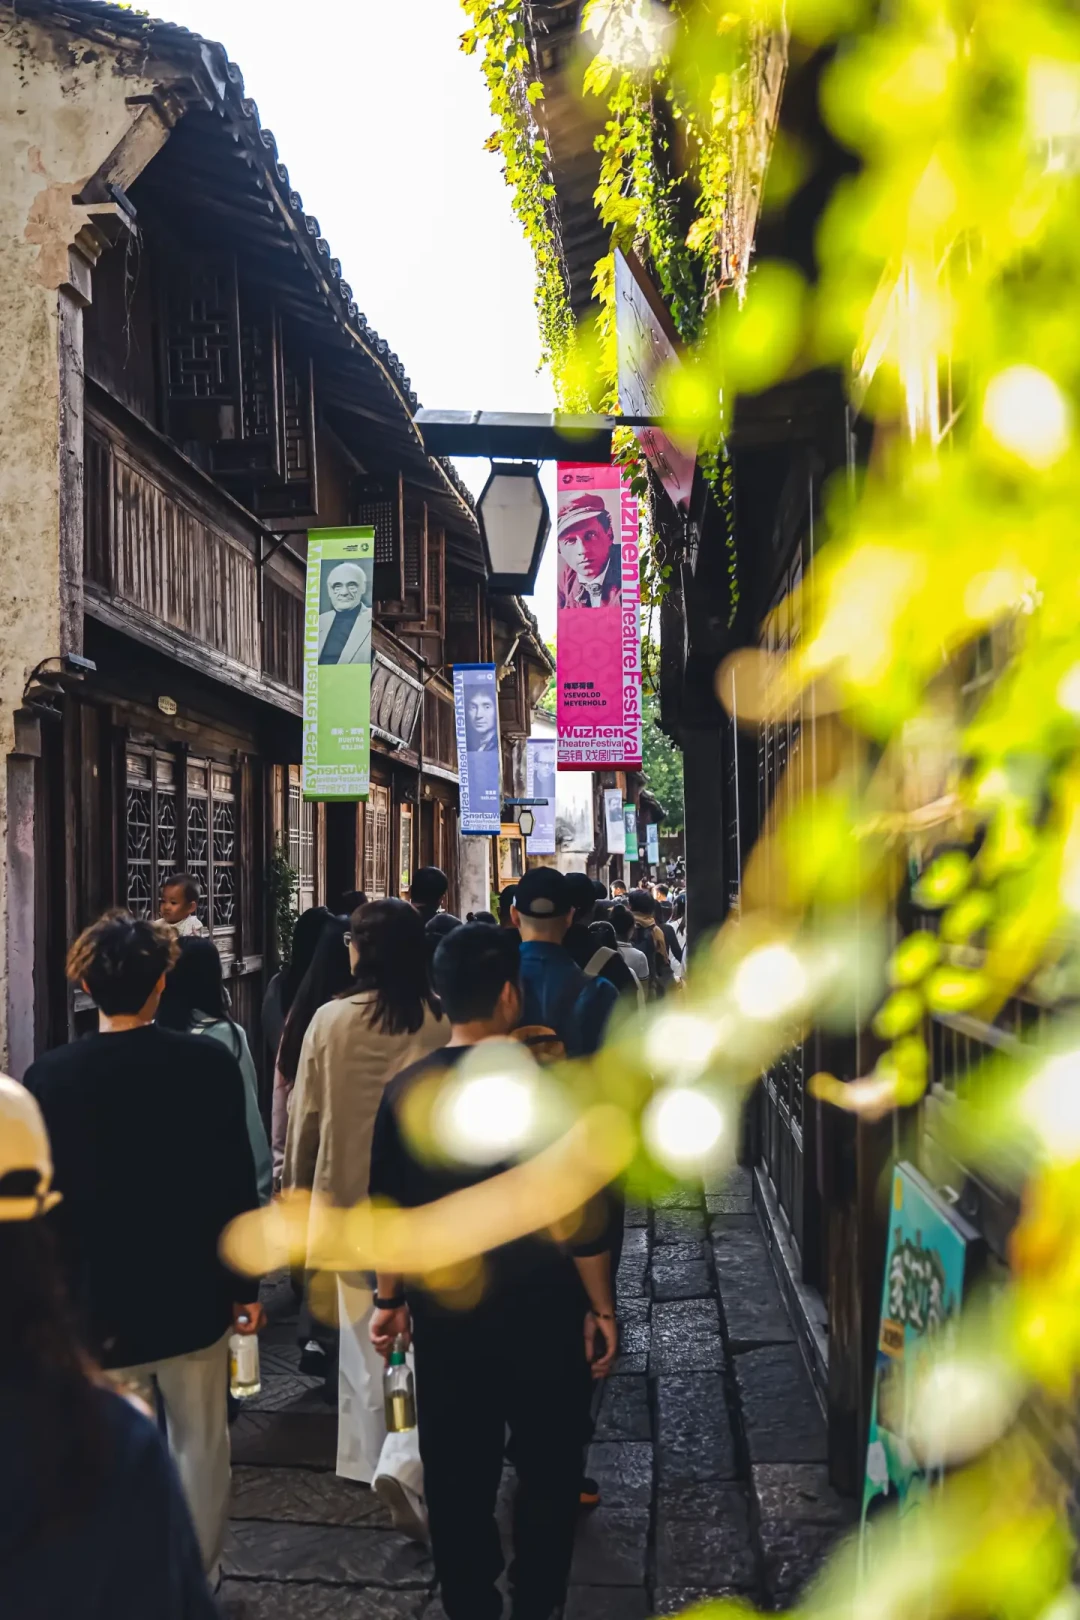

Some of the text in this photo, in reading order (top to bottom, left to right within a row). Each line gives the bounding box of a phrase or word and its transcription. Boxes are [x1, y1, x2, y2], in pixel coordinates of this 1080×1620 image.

[623, 583, 641, 668] Theatre
[624, 672, 642, 760] Festival
[557, 726, 624, 738] Wuzhen
[558, 739, 623, 747] Theatre Festival
[557, 749, 624, 761] 乌镇 戏剧节
